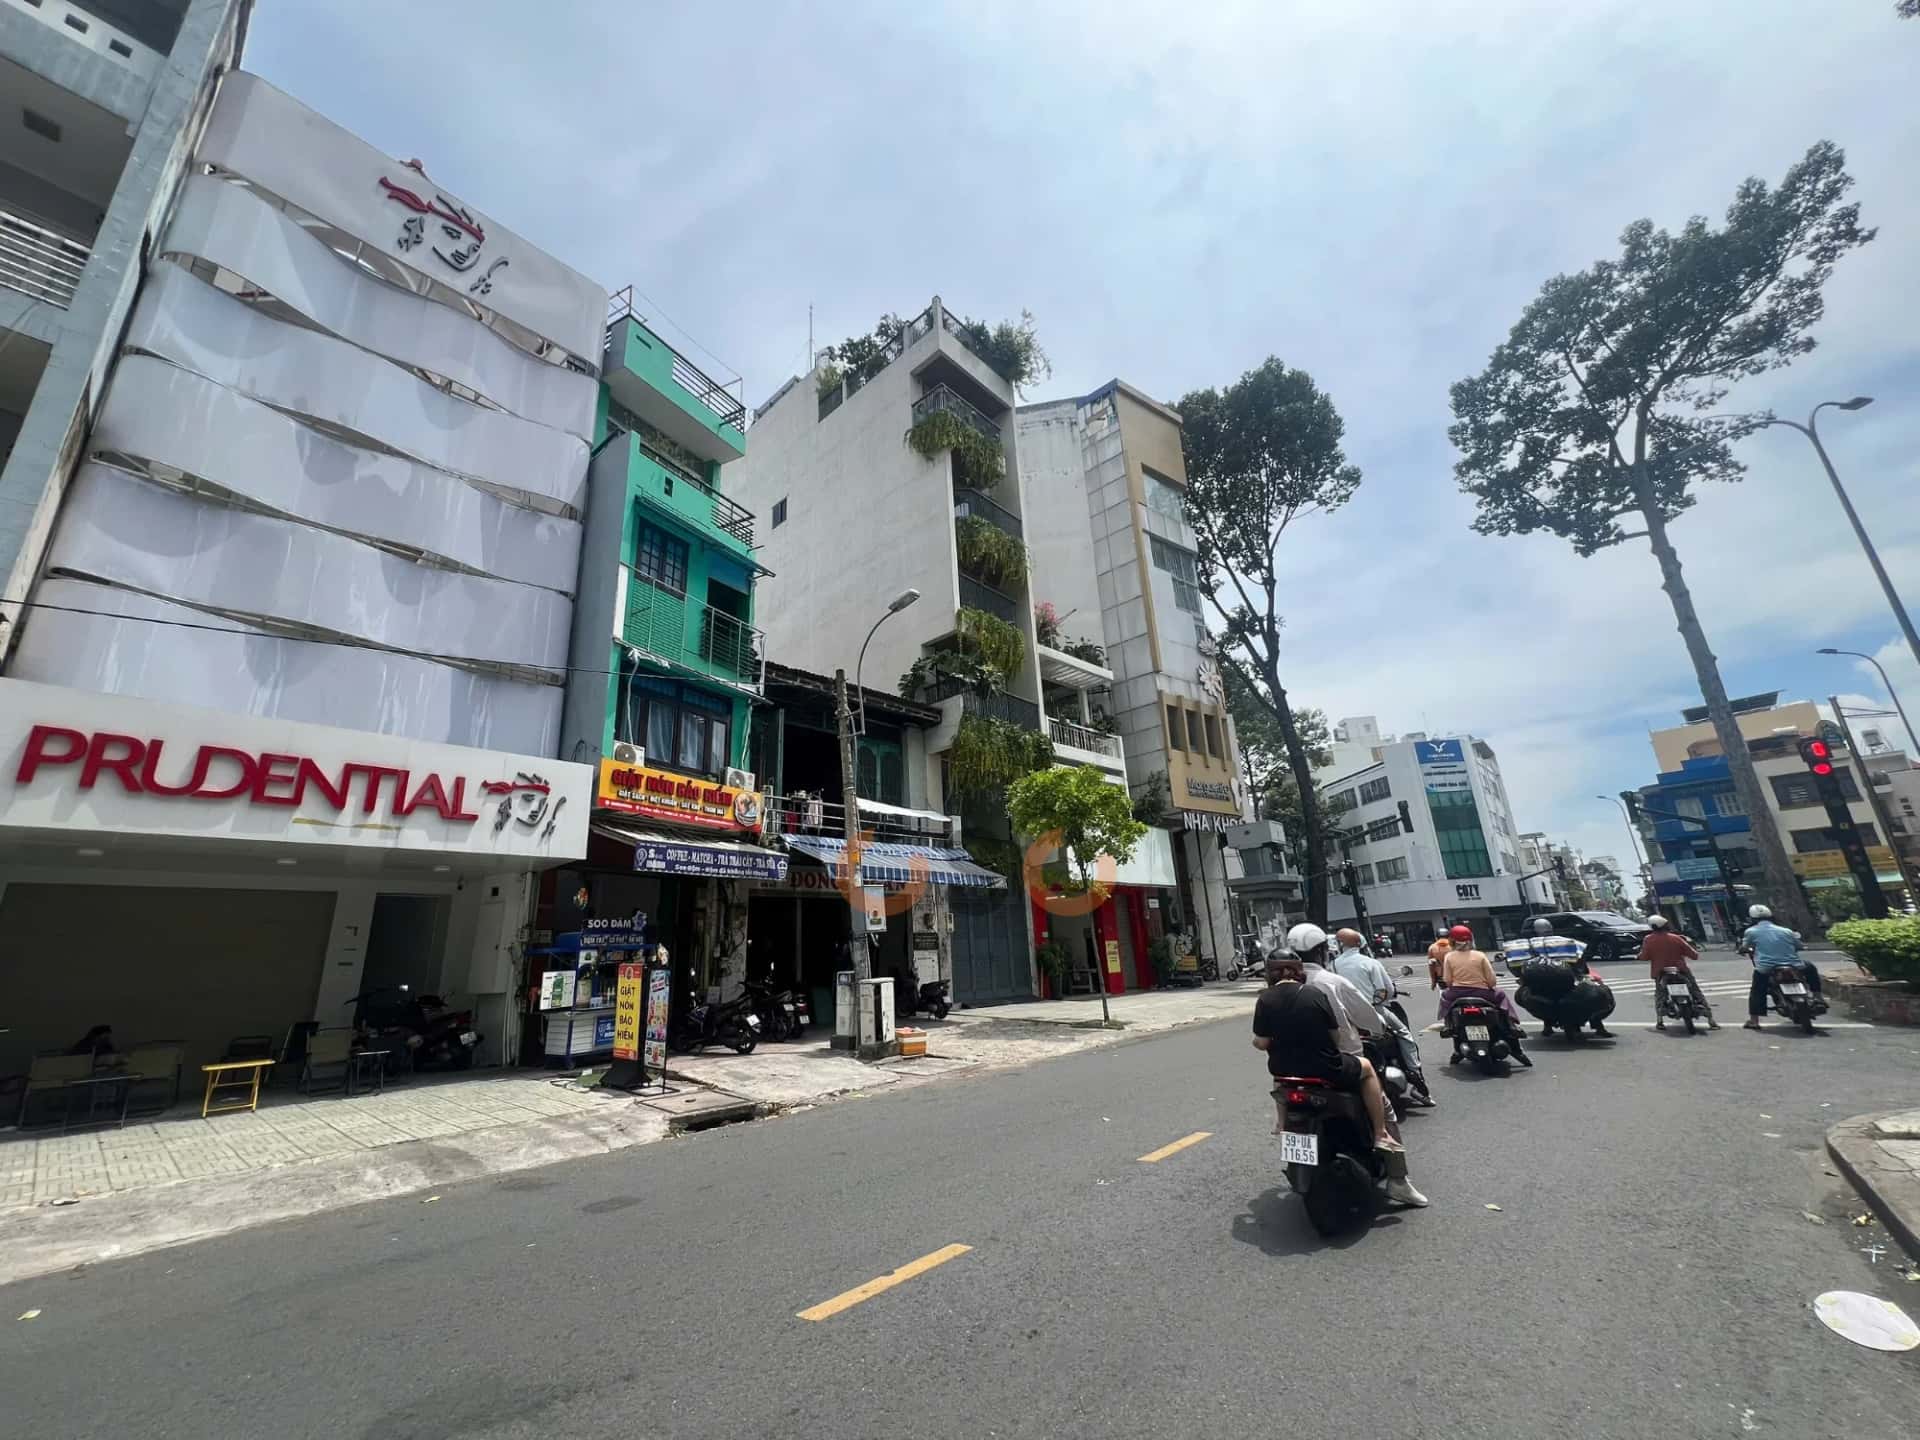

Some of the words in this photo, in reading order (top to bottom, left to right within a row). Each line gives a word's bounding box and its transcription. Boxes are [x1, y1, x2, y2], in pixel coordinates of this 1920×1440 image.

[16, 724, 478, 823] PRUDENTIAL
[1184, 812, 1210, 832] NHA
[1213, 815, 1246, 833] KH
[666, 848, 688, 861] COFFEE
[691, 851, 713, 864] MATCHA
[587, 919, 608, 929] SOO
[620, 984, 634, 997] GIẶT
